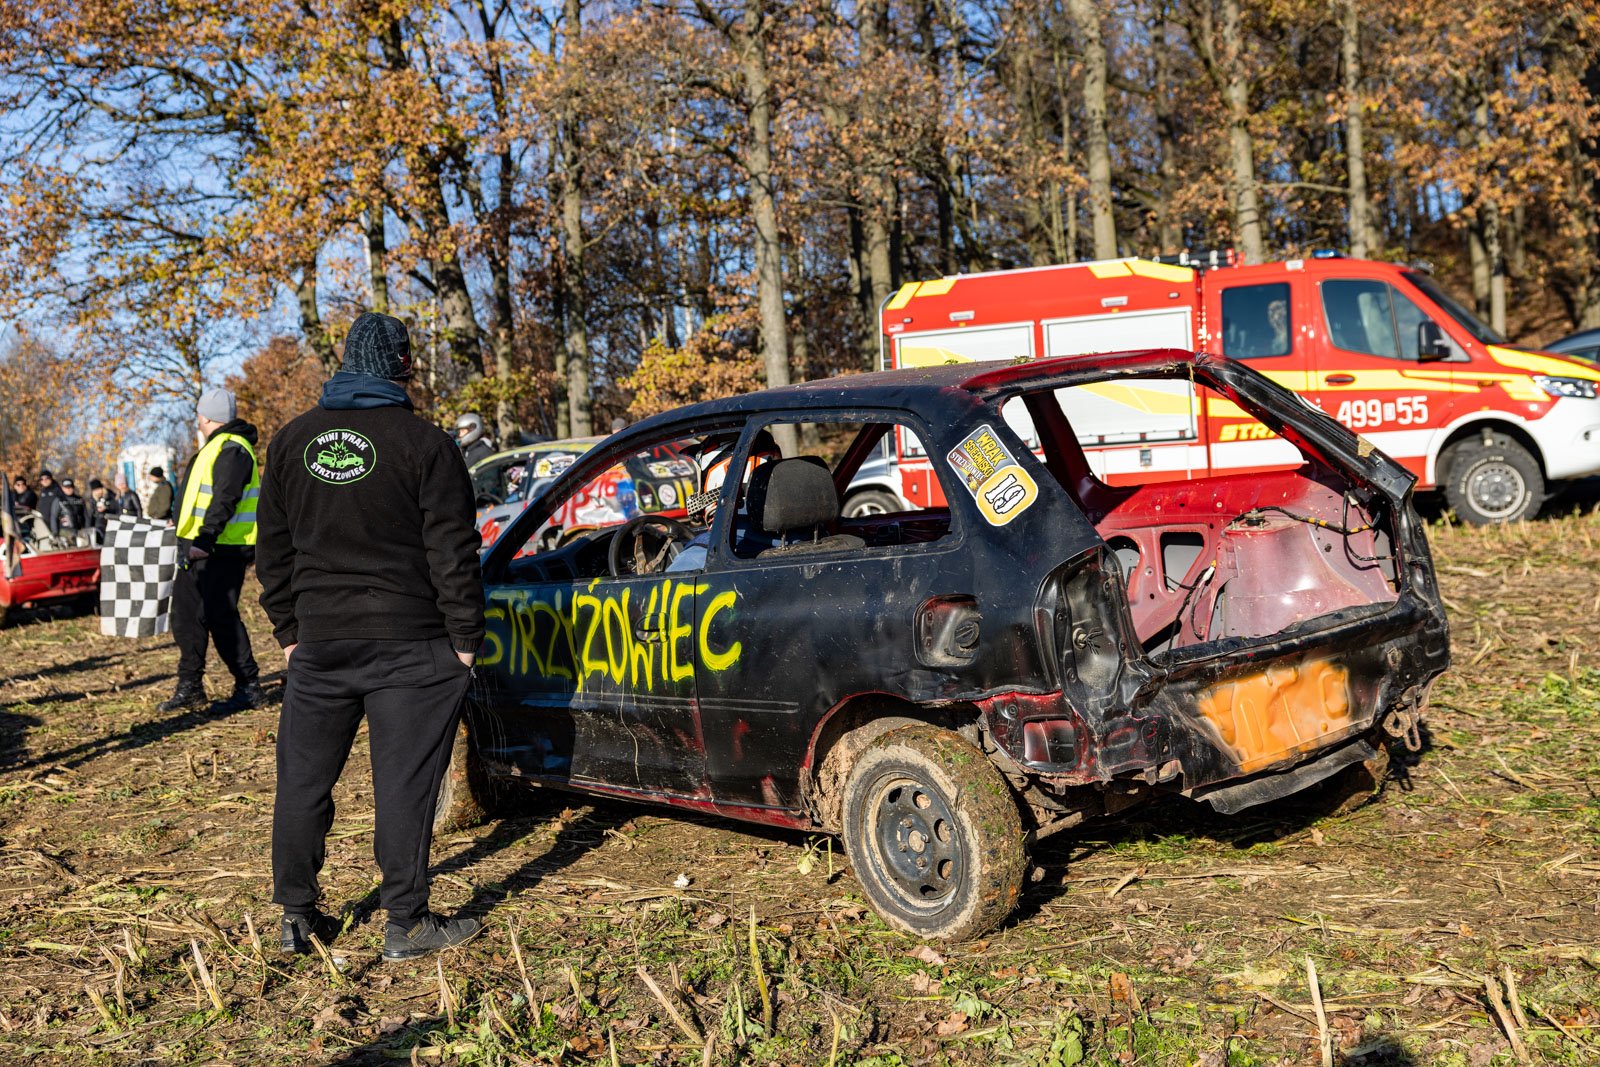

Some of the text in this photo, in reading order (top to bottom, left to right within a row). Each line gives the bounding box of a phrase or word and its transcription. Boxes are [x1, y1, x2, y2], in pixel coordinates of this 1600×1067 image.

[317, 432, 368, 451] MINI WRAK
[976, 431, 1007, 467] WRAK
[310, 462, 366, 480] STRZYŻOWIEC
[984, 473, 1026, 515] 19
